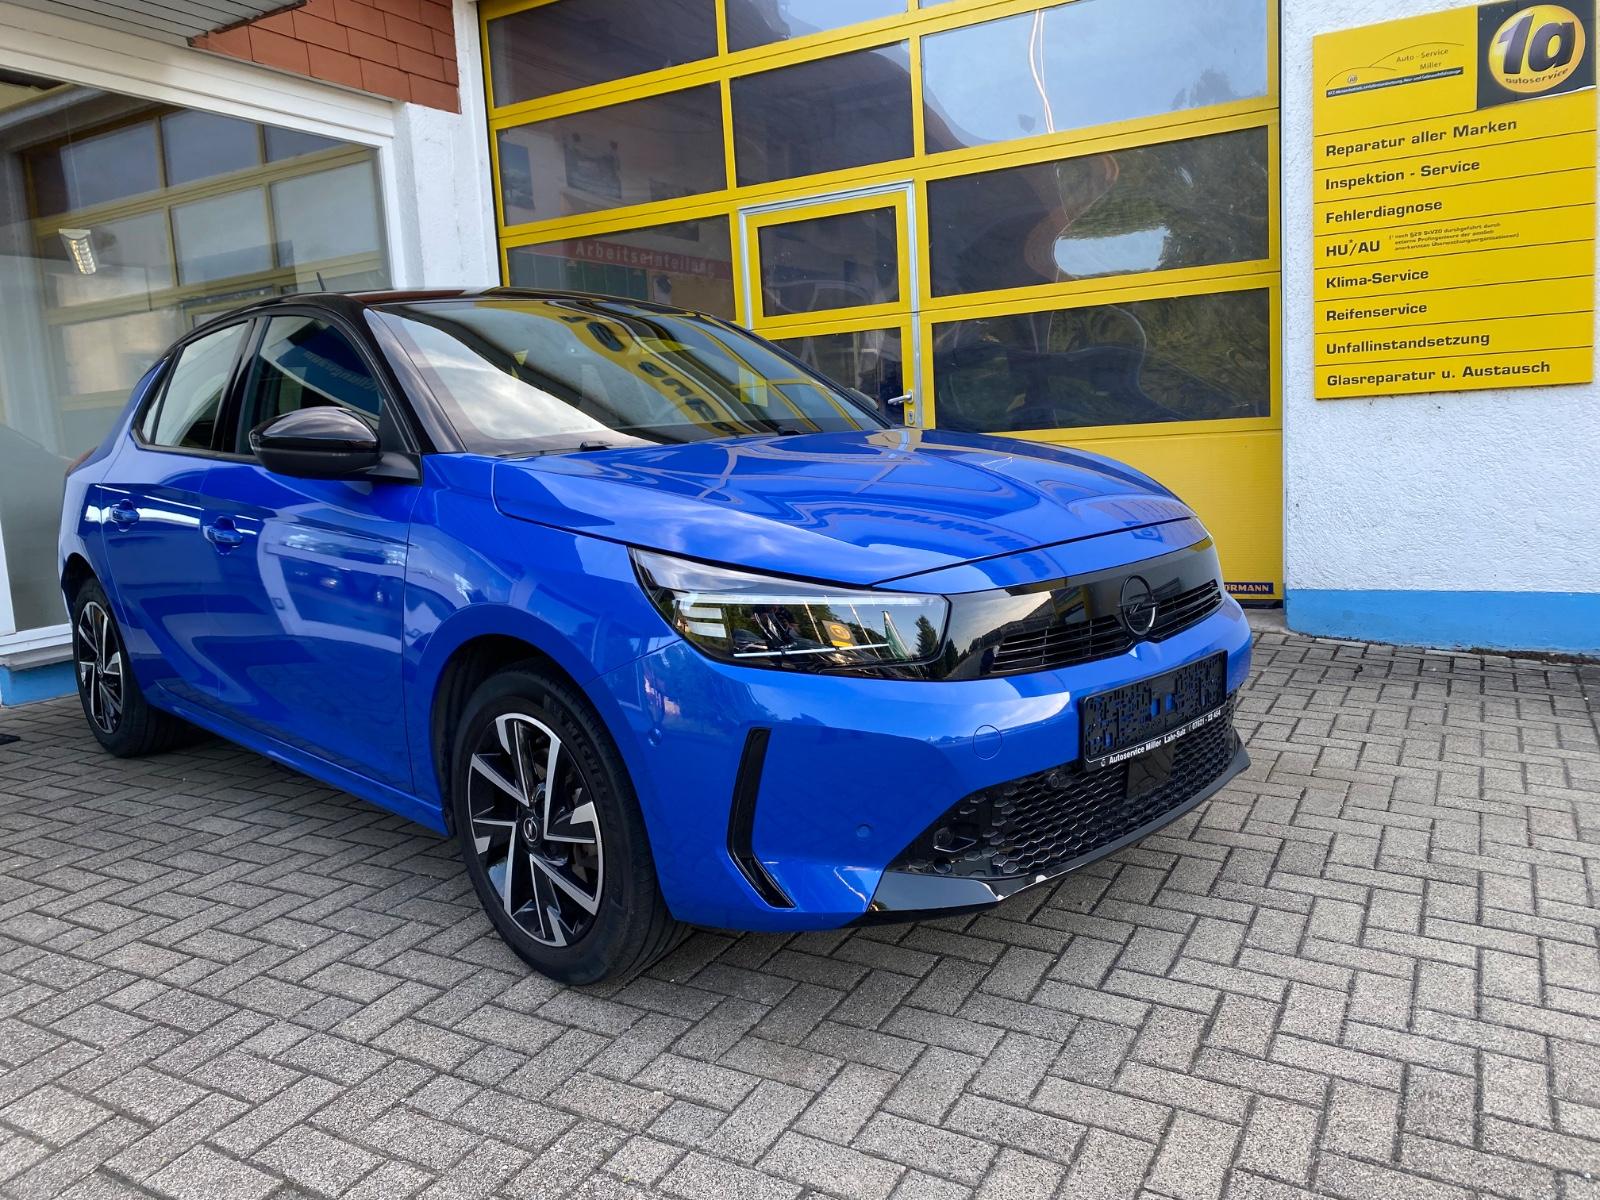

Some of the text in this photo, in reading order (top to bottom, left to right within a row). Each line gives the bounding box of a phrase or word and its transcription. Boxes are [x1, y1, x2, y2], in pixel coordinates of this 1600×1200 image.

[1498, 14, 1575, 75] 1a
[1396, 54, 1415, 64] Auto
[1420, 48, 1449, 60] Service
[1419, 61, 1442, 71] Miller
[1505, 68, 1568, 85] autoservice
[1325, 120, 1517, 157] Reparatur aller Marken
[1325, 169, 1405, 191] Inspektion
[1420, 160, 1480, 178] Service
[1325, 201, 1443, 224] Fehlerdiagnose
[1326, 269, 1429, 289] Klima-Service
[1326, 303, 1427, 322] Reifenservice
[1326, 333, 1490, 355] Unfallinstandsetzung
[1327, 361, 1550, 387] Glasreparatur u. Austausch
[1109, 746, 1144, 764] Autoservice
[1146, 740, 1161, 751] Miller
